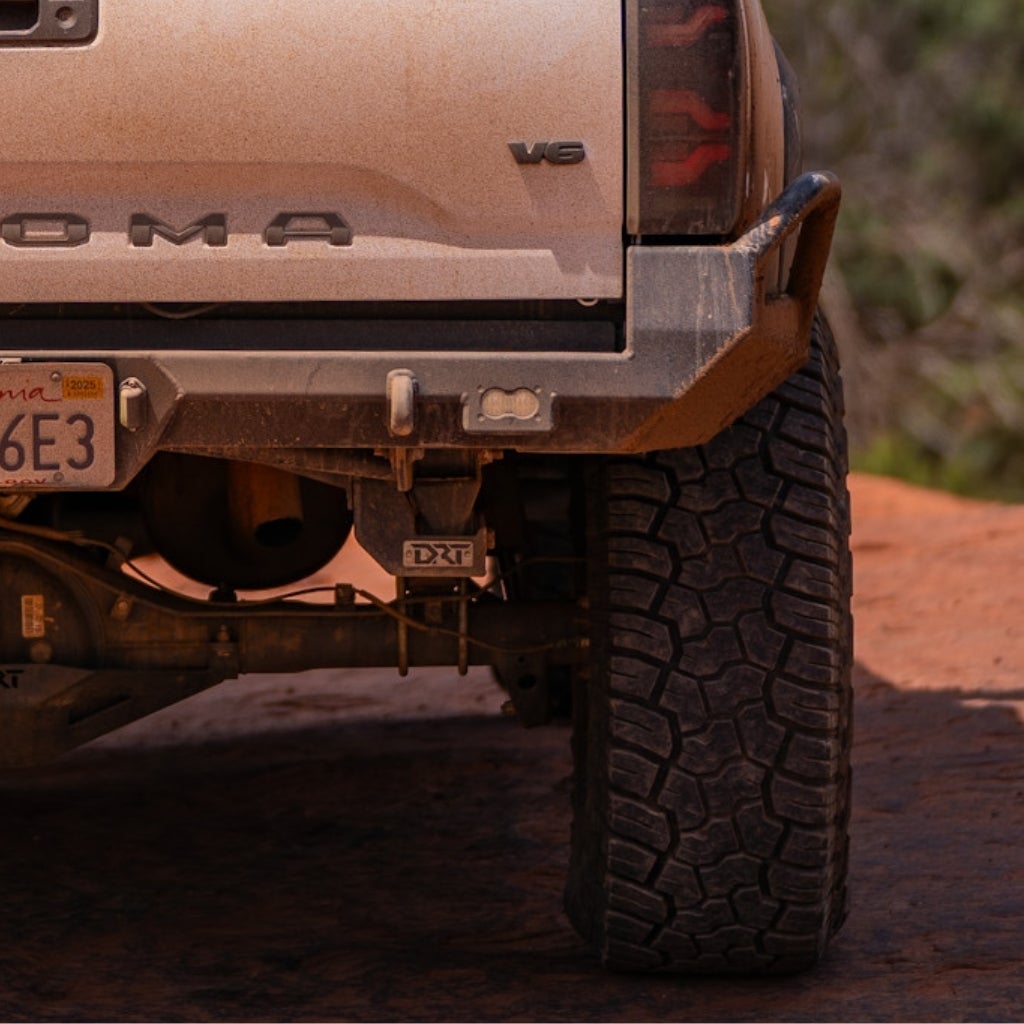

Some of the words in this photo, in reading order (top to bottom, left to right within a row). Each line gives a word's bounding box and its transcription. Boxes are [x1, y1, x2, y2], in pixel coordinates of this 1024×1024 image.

[507, 141, 585, 164] V6
[69, 380, 96, 390] 2025
[410, 543, 471, 564] DRT
